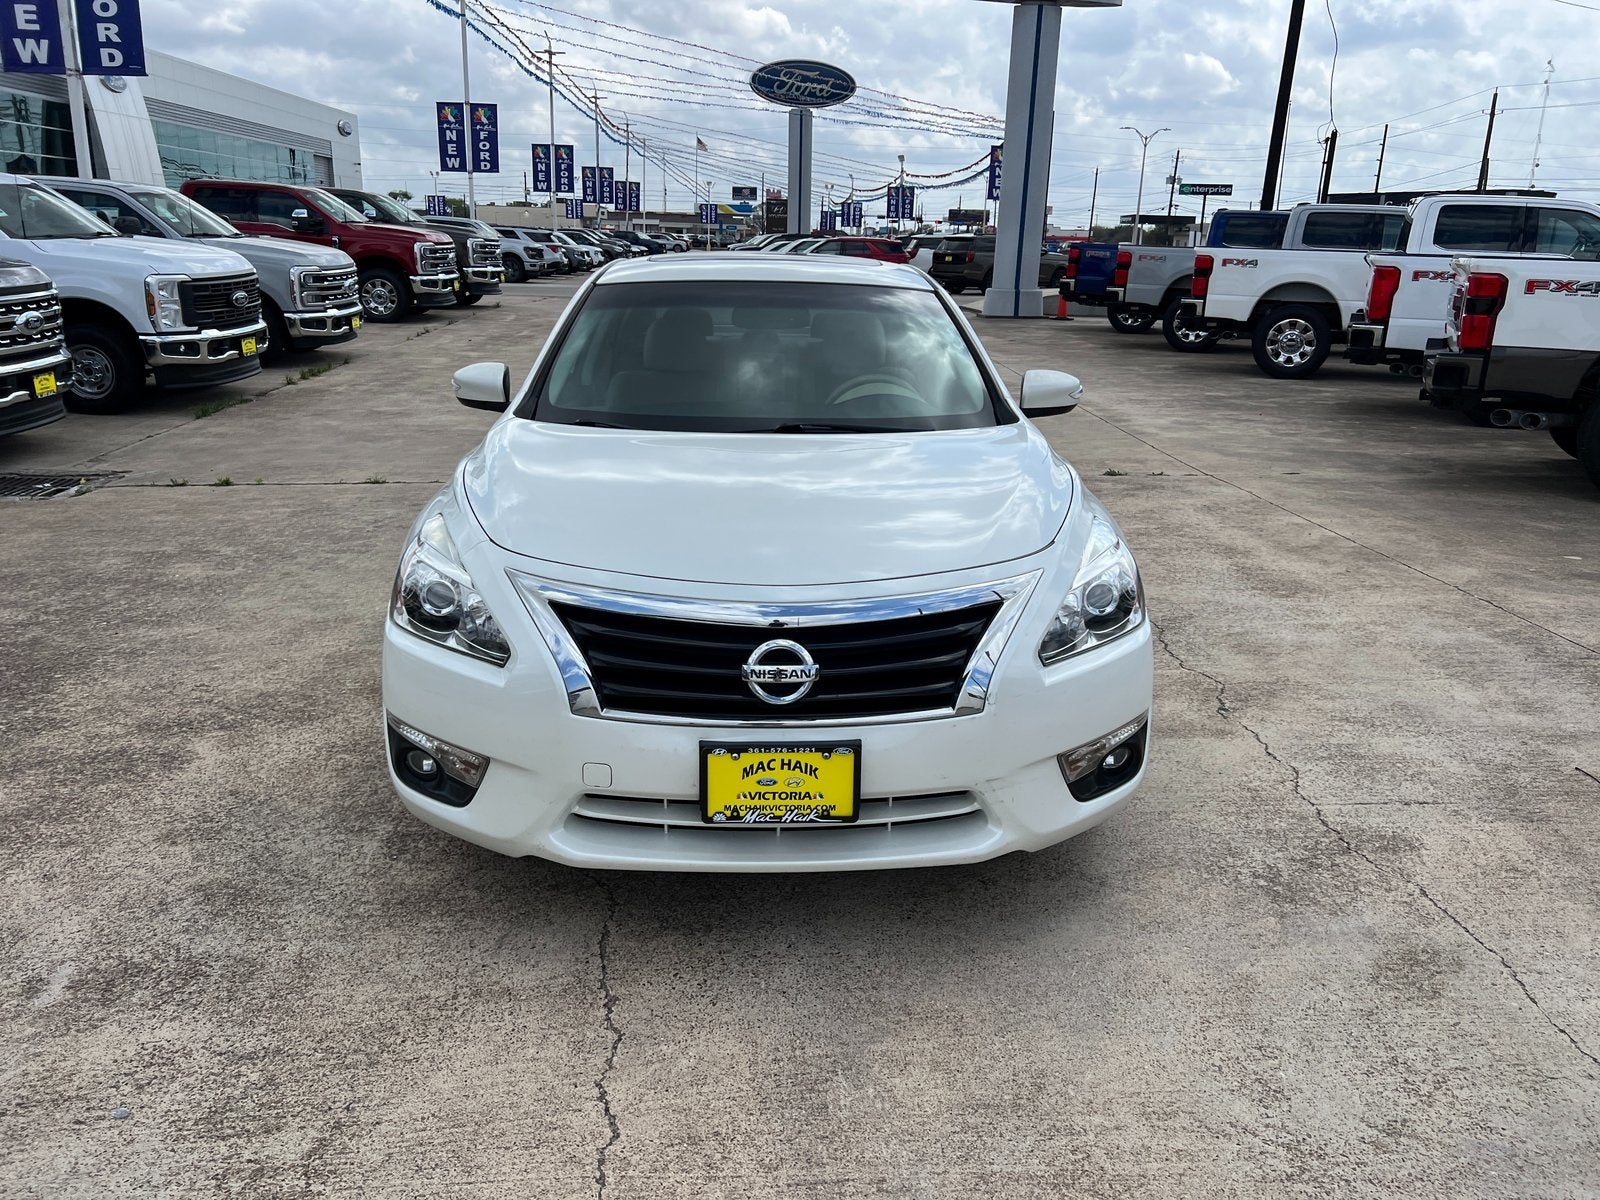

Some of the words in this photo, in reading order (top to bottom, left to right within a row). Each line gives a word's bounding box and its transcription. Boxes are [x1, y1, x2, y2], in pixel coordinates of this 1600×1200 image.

[773, 67, 835, 97] Ford
[445, 129, 460, 169] NEW
[478, 131, 491, 170] FORD
[537, 163, 548, 190] NEW
[560, 164, 569, 191] FORD
[585, 181, 594, 202] NEW
[1182, 185, 1232, 194] enterprise
[889, 200, 897, 218] NEW
[1138, 254, 1168, 263] FX4
[1221, 258, 1259, 267] FX4
[1524, 279, 1600, 295] FX4
[750, 668, 813, 680] NISSAN
[741, 758, 777, 780] MAC
[780, 758, 819, 780] HAIK
[748, 791, 813, 801] VICTORIA
[741, 808, 781, 824] Mac
[781, 808, 826, 824] Haik
